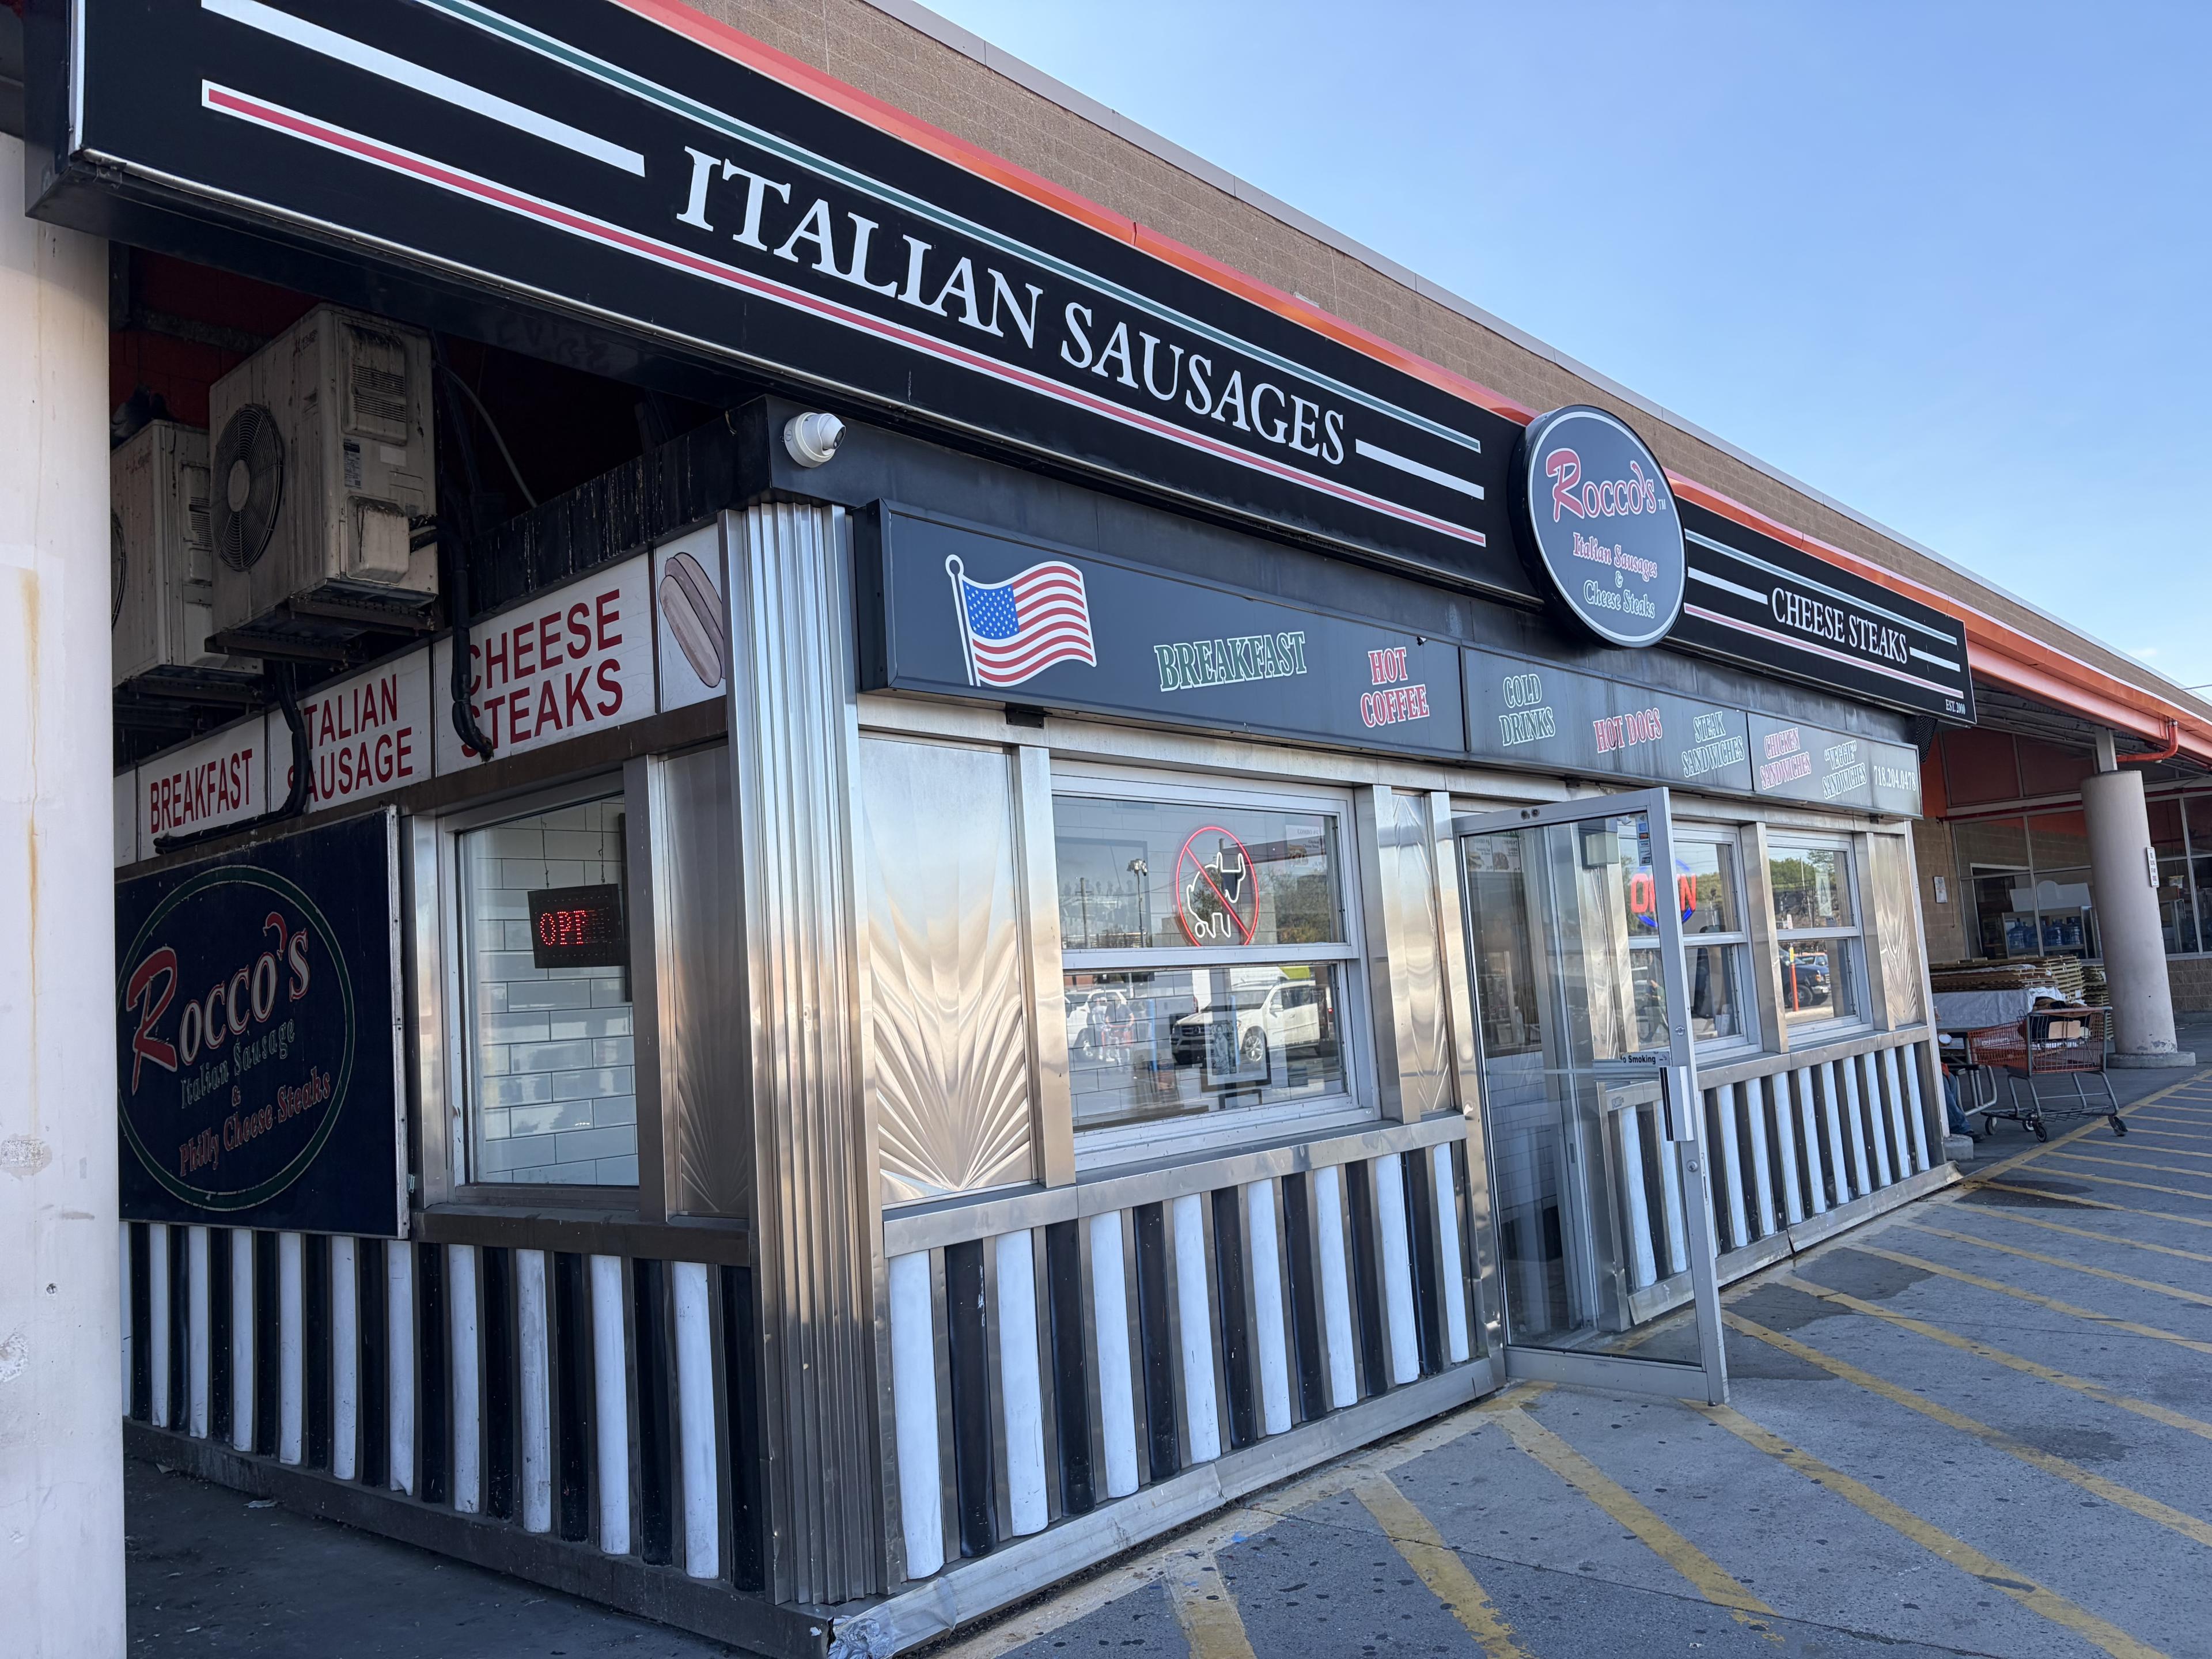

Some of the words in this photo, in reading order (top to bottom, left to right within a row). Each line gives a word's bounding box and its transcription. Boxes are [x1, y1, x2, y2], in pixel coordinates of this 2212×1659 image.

[676, 146, 1043, 349] ITALIAN
[1060, 302, 1345, 465] SAUSAGES
[1573, 532, 1612, 566] Italian
[1614, 544, 1657, 581] Sausages
[1584, 580, 1621, 611] Cheese
[1623, 590, 1655, 619] Steaks
[1615, 571, 1623, 588] &
[470, 589, 623, 696] CHEESE
[1772, 587, 1844, 643] CHEESE
[1849, 615, 1907, 664] STEAKS
[1154, 631, 1307, 692] BREAKFAST
[1368, 646, 1409, 685] HOT
[1360, 684, 1430, 728] COFFEE
[1503, 673, 1542, 709] COLD
[302, 674, 397, 750] TALIAN
[1499, 706, 1556, 747] DRINKS
[1593, 716, 1624, 753] HOT
[1624, 707, 1662, 746] DOGS
[1694, 711, 1726, 743] STEAK
[1681, 736, 1745, 778] SANDWICHES
[1764, 727, 1800, 760] CHICKEN
[150, 748, 252, 834] BREAKFAST
[1760, 751, 1812, 790] SANDWICHES
[1822, 762, 1867, 800] SANDWICHES
[1873, 765, 1916, 791] 718.204.0478
[1630, 873, 1696, 913] ON
[180, 1060, 229, 1109] Italian
[233, 1018, 295, 1077] Sausage
[1628, 1055, 1656, 1065] Smoking
[232, 1085, 241, 1107] &
[179, 1127, 219, 1177] Philly
[224, 1104, 273, 1152] Cheese
[278, 1066, 330, 1123] Steaks
